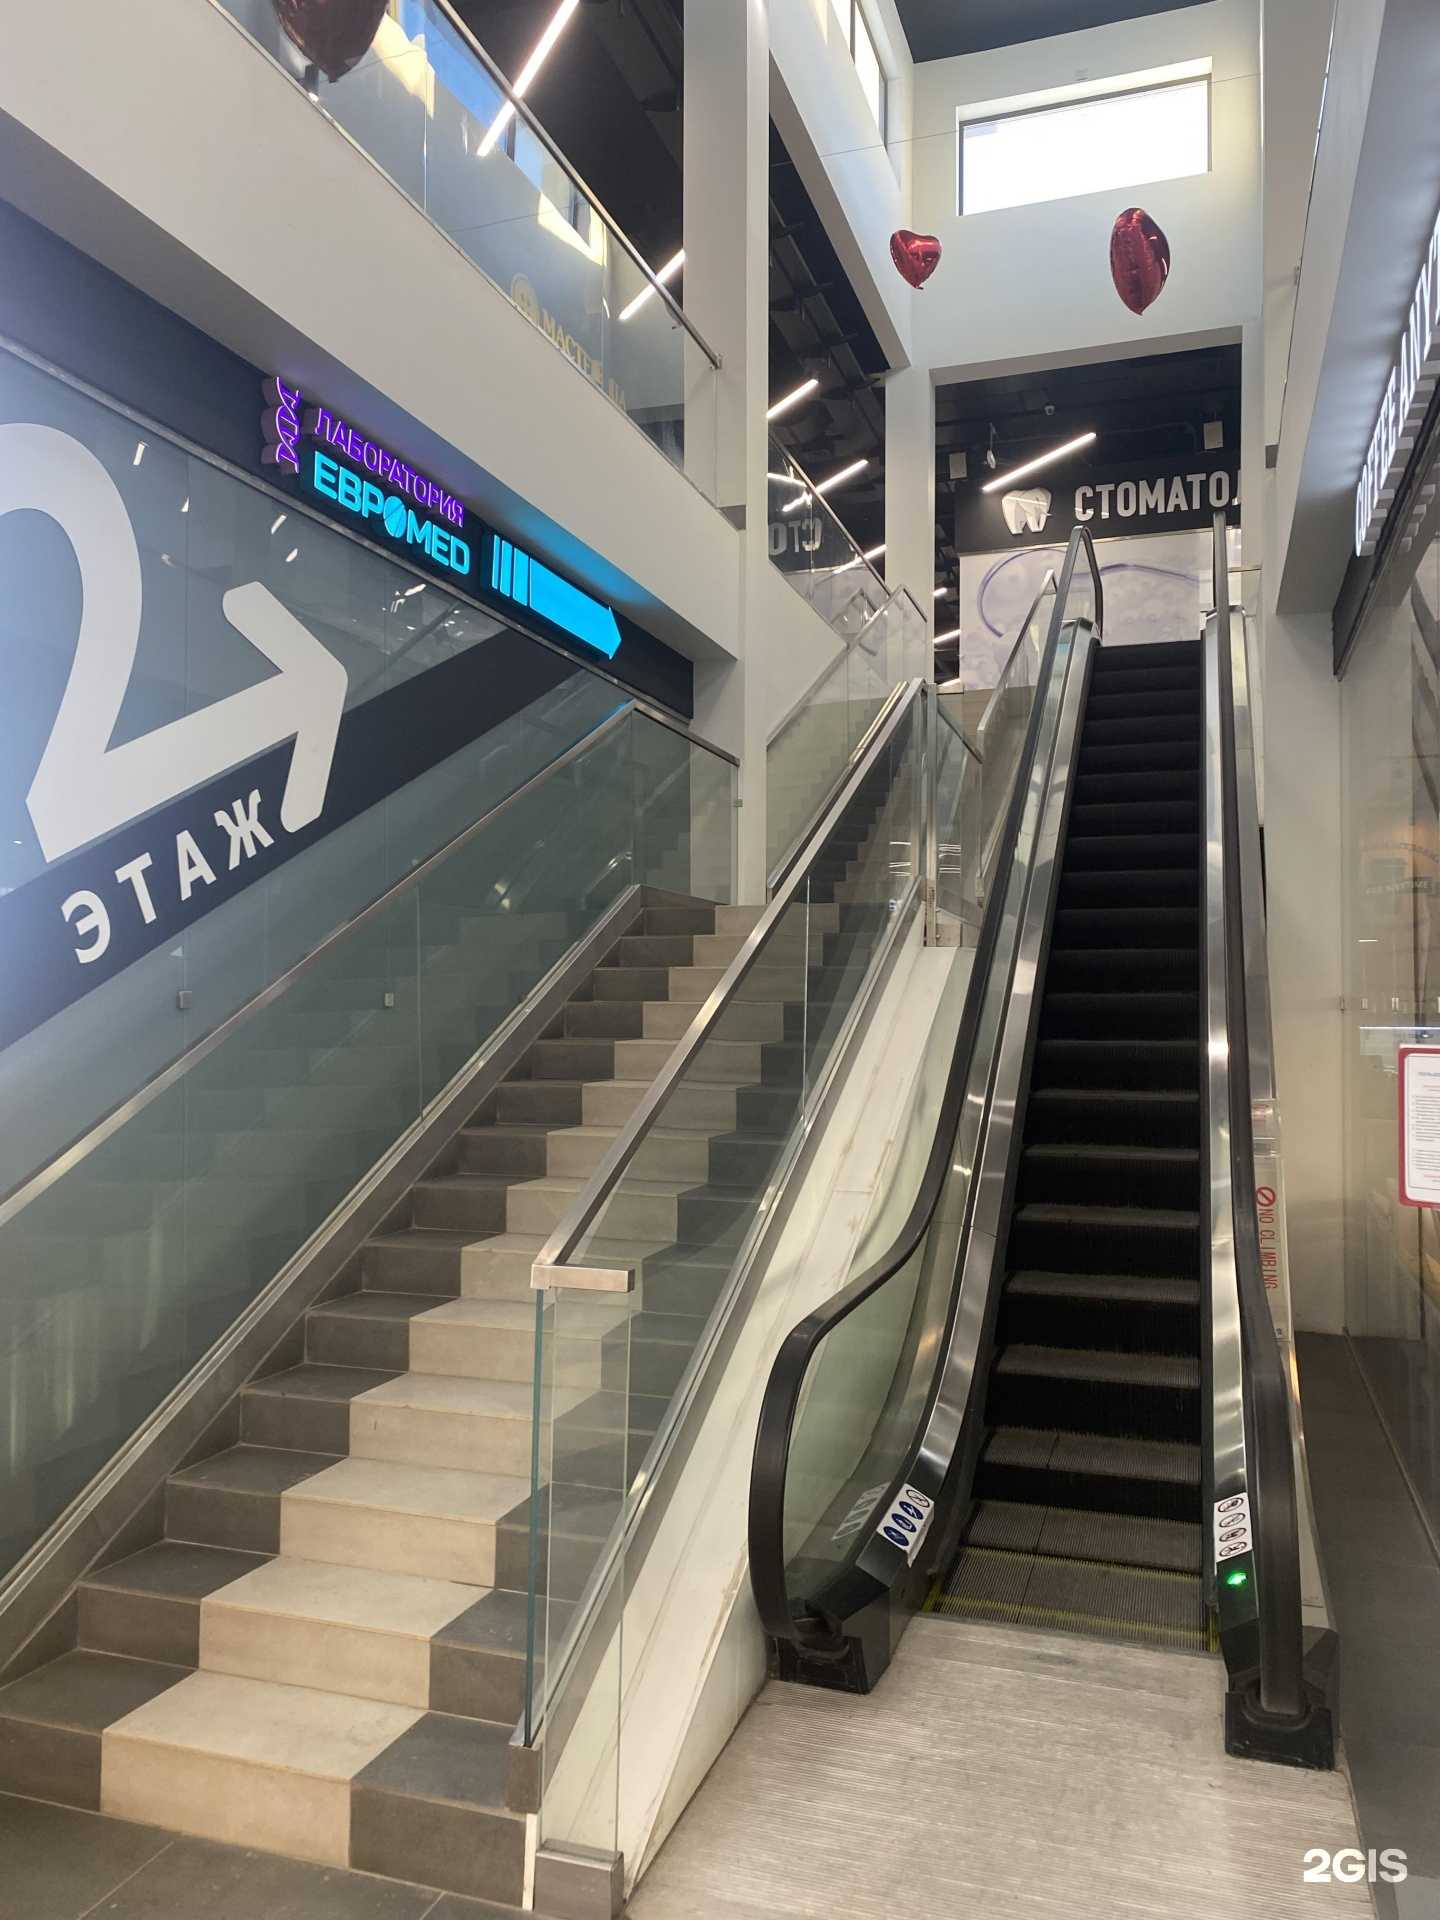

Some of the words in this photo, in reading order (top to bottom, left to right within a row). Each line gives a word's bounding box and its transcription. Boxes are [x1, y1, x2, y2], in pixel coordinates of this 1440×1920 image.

[314, 407, 465, 528] ЛАБОРАТОРИЯ
[1356, 366, 1396, 557] COFFEE
[61, 788, 274, 963] ЭТАЖ
[1259, 1208, 1275, 1224] NO
[1260, 1229, 1279, 1289] CLIMBING
